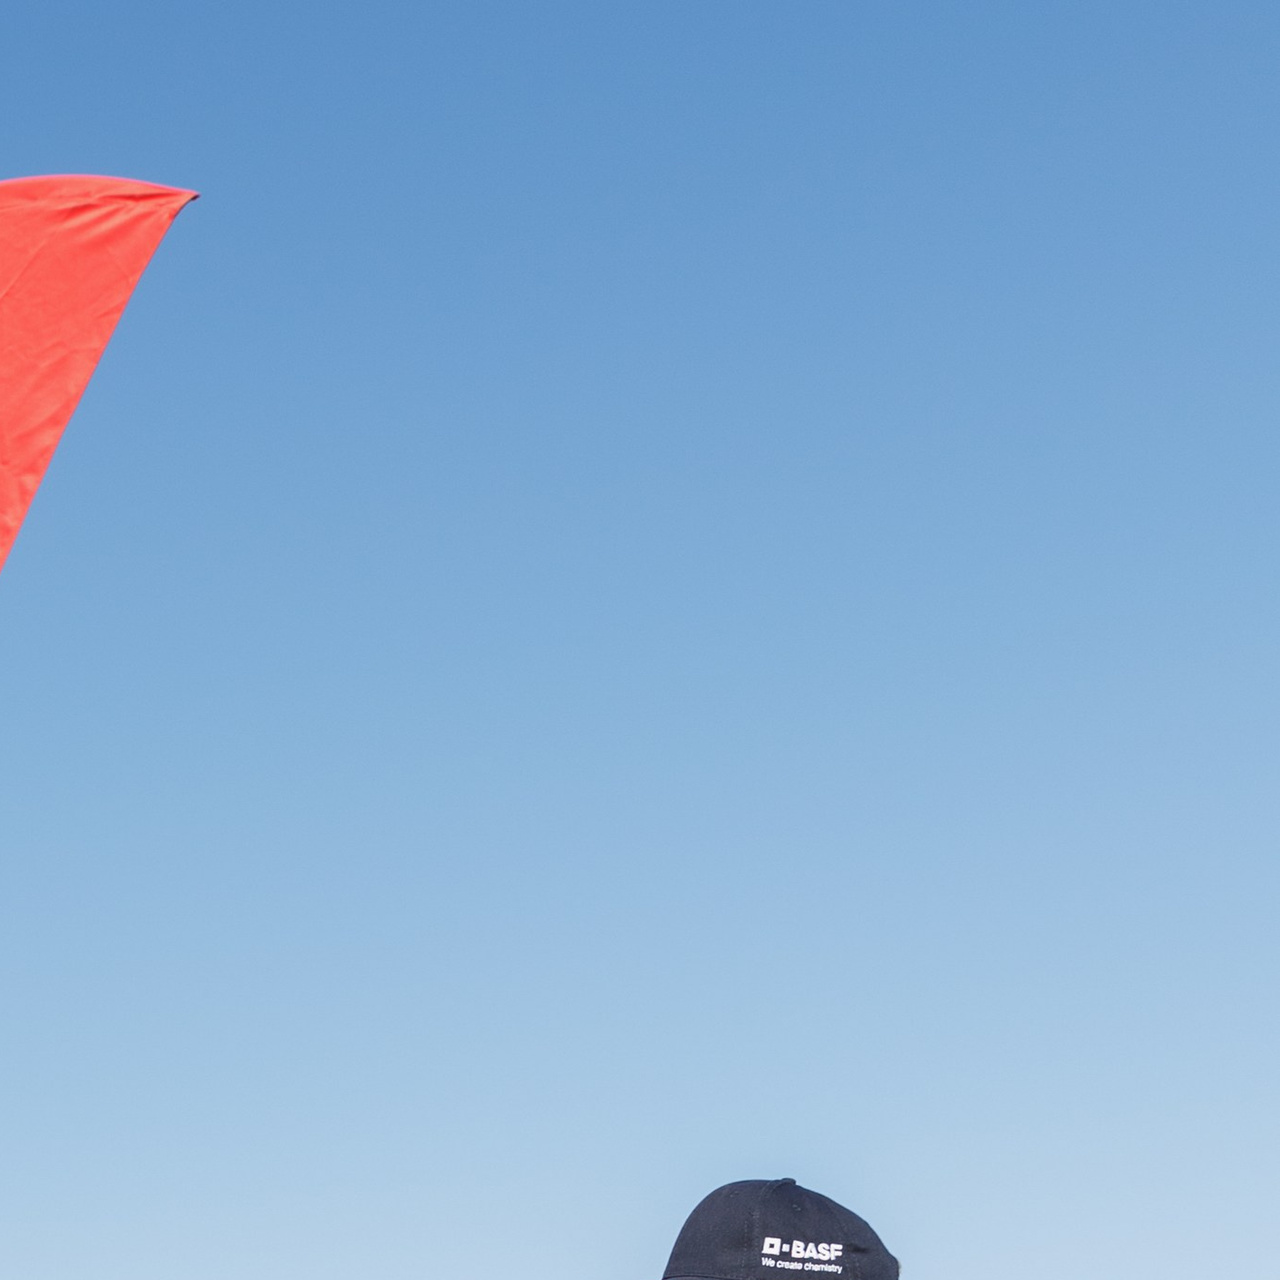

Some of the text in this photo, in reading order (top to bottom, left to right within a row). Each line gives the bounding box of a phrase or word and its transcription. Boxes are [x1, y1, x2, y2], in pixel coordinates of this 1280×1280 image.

[791, 1240, 843, 1261] BASF
[761, 1257, 842, 1274] We create chemistry
